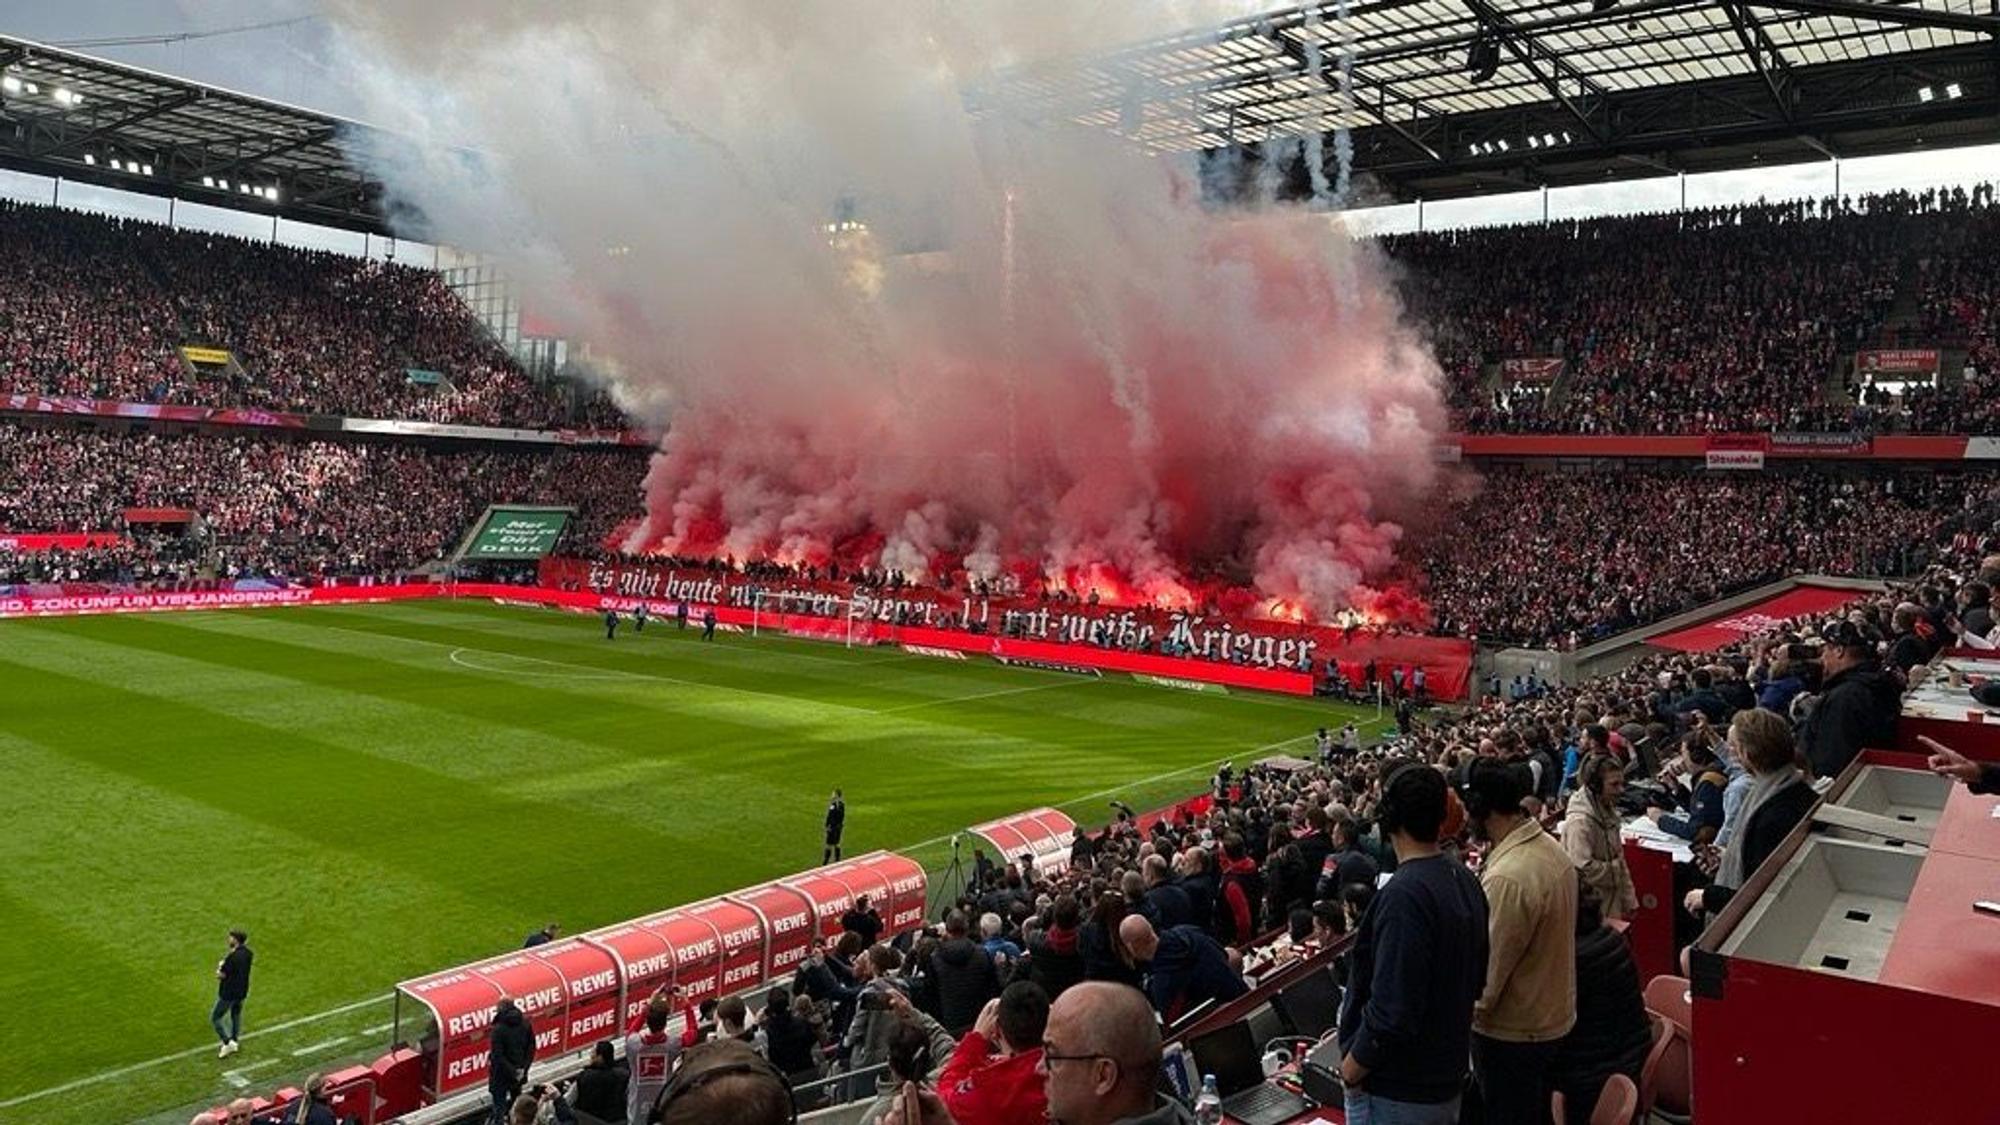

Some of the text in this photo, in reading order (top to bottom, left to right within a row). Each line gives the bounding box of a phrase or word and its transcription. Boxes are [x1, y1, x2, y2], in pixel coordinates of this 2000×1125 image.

[664, 570, 722, 604] heute
[1169, 612, 1317, 668] Krieger
[894, 875, 922, 895] REWE
[774, 912, 808, 935] REWE
[894, 906, 922, 927] REWE
[723, 924, 761, 949] REWE
[677, 938, 717, 964] REWE
[628, 953, 670, 980] REWE
[724, 960, 761, 985] REWE
[570, 968, 616, 997] REWE
[513, 986, 562, 1014] REWE
[570, 1009, 616, 1038] REWE
[447, 1051, 491, 1080] REW
